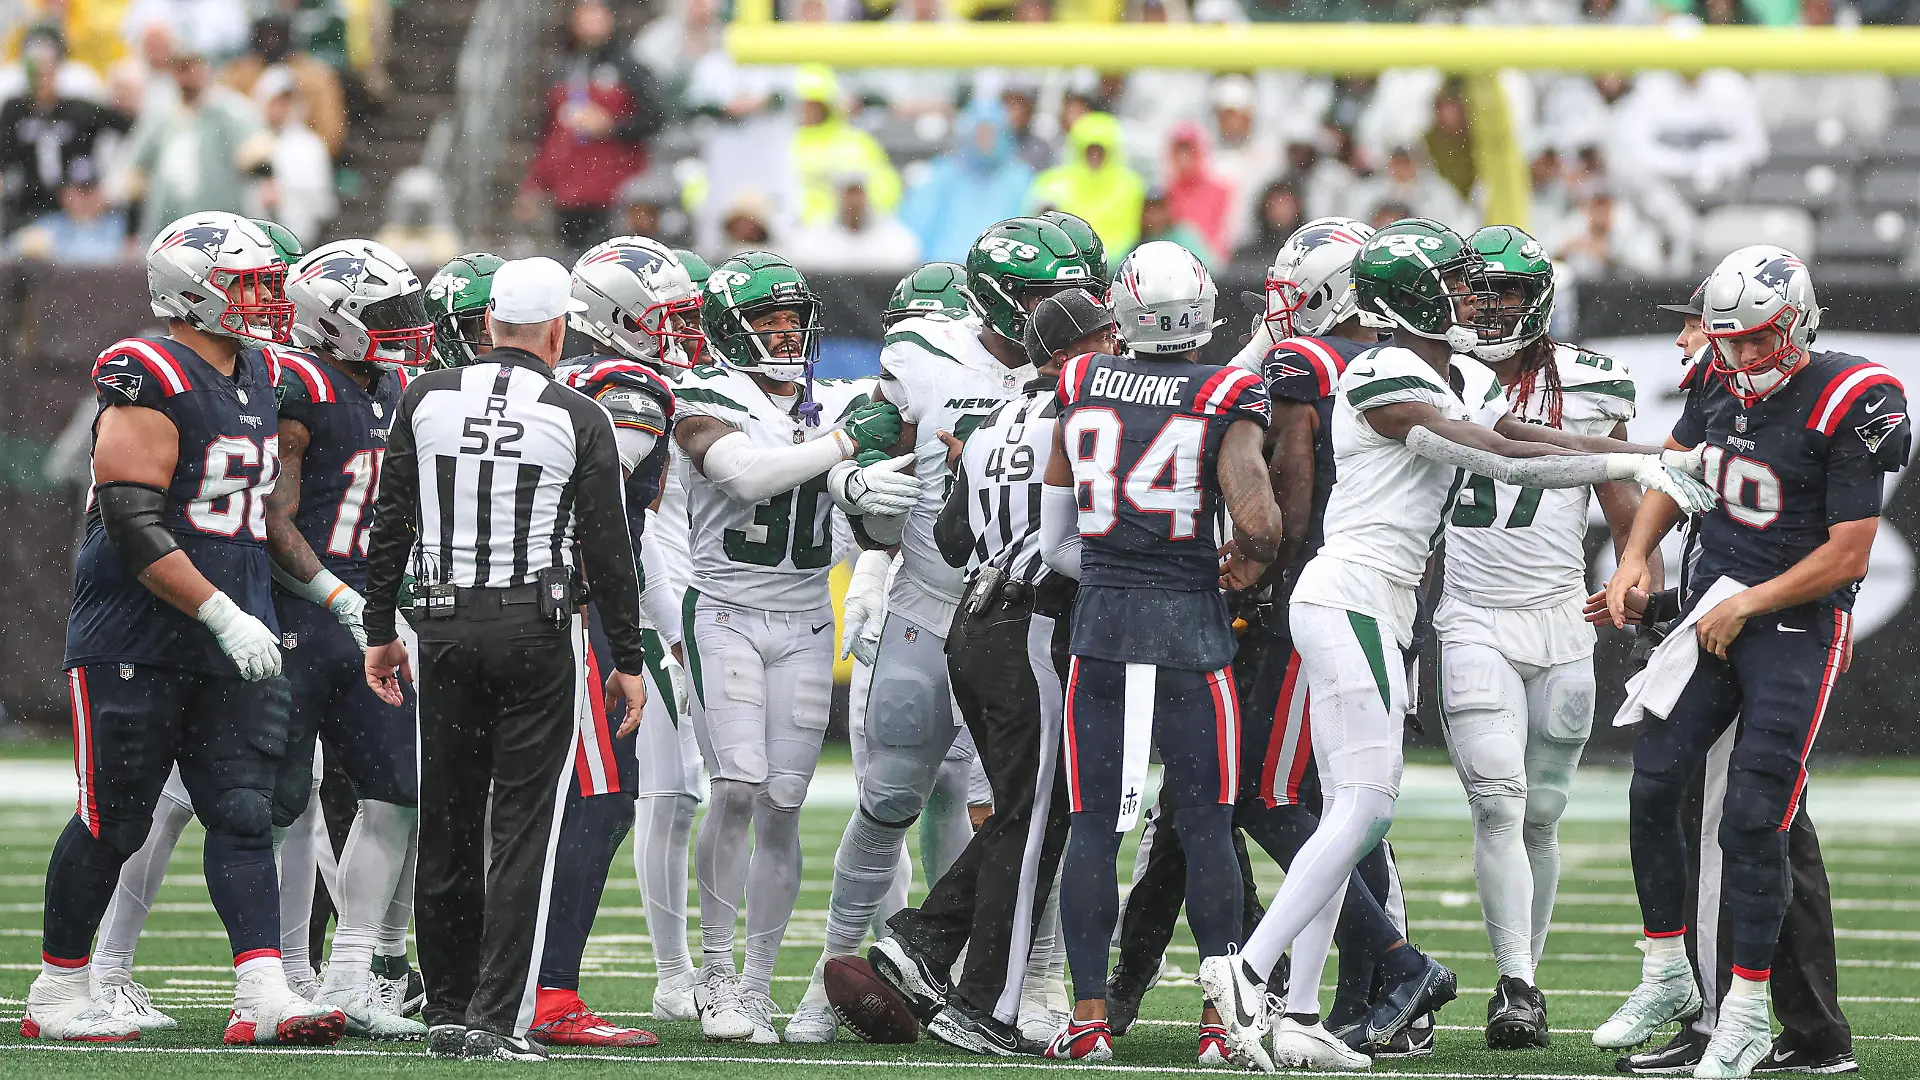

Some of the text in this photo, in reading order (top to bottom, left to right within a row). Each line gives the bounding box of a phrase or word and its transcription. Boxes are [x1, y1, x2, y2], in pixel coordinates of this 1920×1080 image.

[1367, 234, 1443, 250] JETS
[1156, 339, 1197, 352] PATRIOTS
[1089, 366, 1189, 407] BOURNE
[485, 397, 507, 418] R
[943, 398, 1002, 409] NEW
[460, 417, 524, 459] 52
[1726, 435, 1756, 451] PATRIOTS
[984, 445, 1035, 483] 49
[1063, 406, 1209, 541] 84
